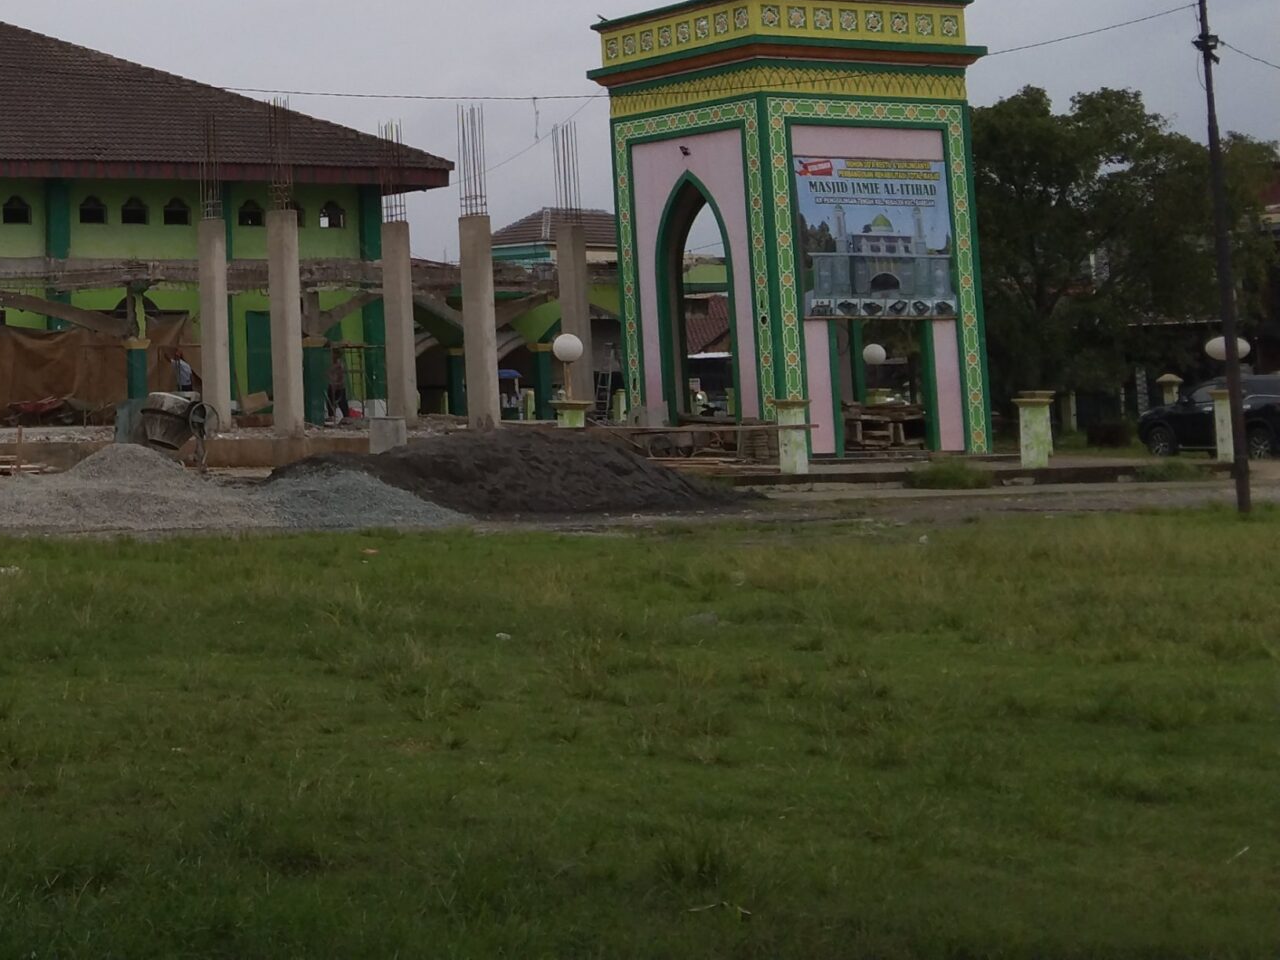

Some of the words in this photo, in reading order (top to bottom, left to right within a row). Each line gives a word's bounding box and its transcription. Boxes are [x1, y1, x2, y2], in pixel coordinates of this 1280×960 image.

[808, 180, 848, 194] MASJID
[852, 182, 881, 195] JAMIE
[884, 183, 937, 196] AL-ITIHAD
